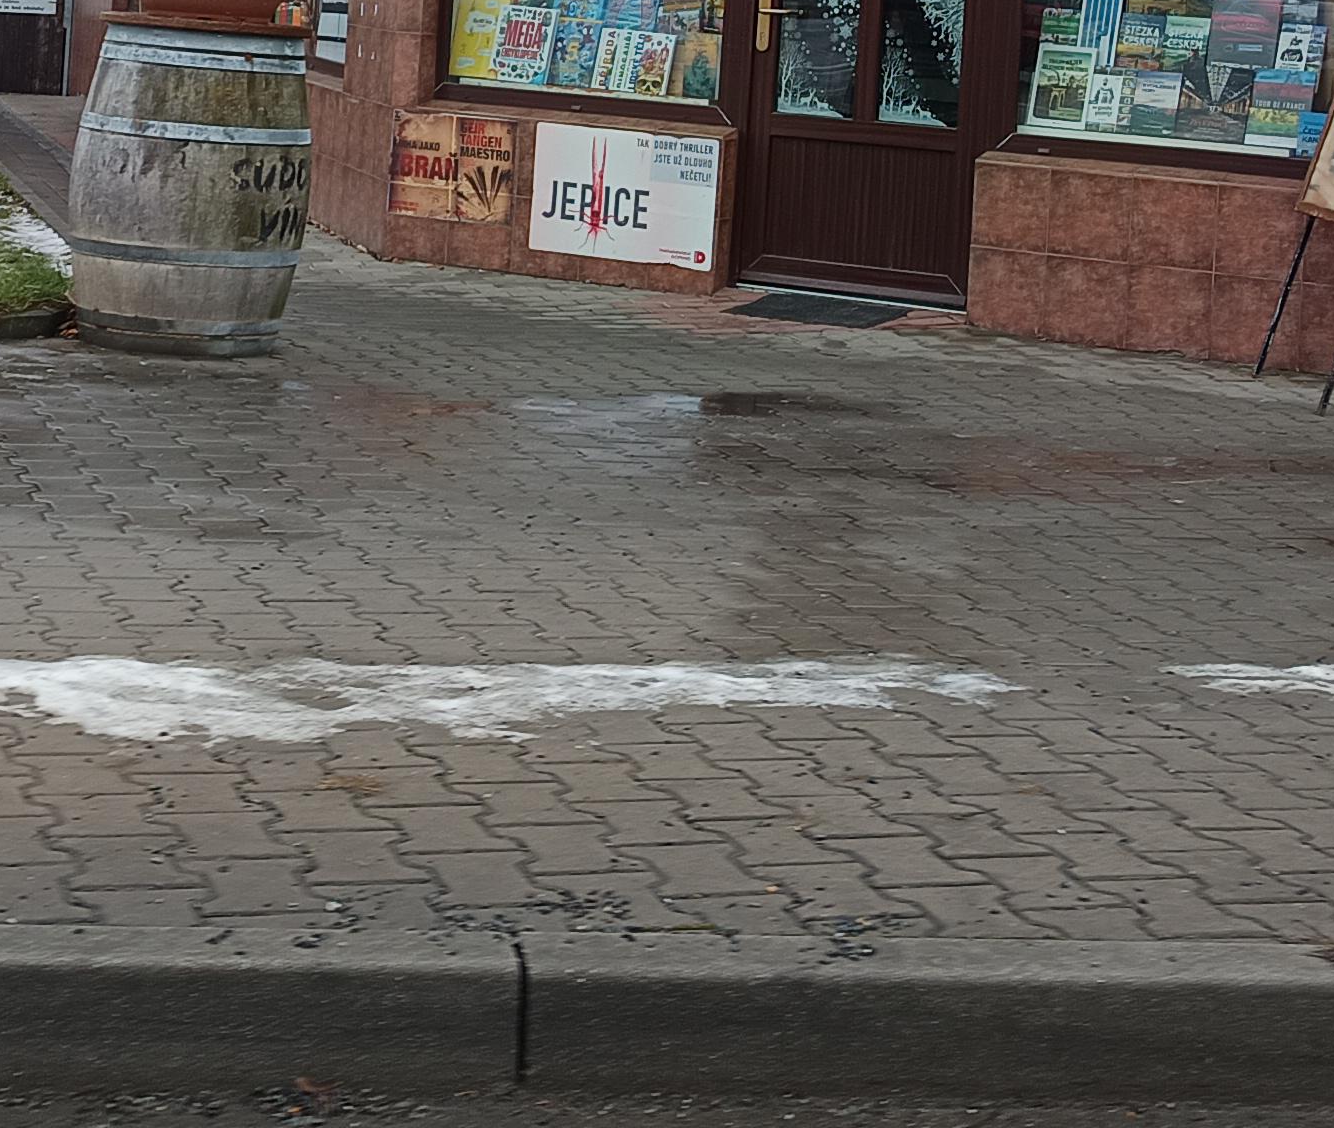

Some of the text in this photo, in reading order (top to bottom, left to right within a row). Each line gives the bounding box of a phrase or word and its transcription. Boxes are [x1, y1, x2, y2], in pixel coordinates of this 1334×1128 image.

[505, 19, 545, 51] MEGA
[1124, 25, 1161, 39] STEZKA
[1168, 27, 1205, 40] STEZKA
[418, 141, 441, 152] JAKO
[460, 134, 503, 149] TANGEN
[637, 138, 714, 155] TAK DOBRÝ THRILLER
[460, 146, 511, 162] MAESTRO
[654, 154, 713, 169] JSTE UŽ DLOUHO
[679, 169, 712, 183] NEČETLI!
